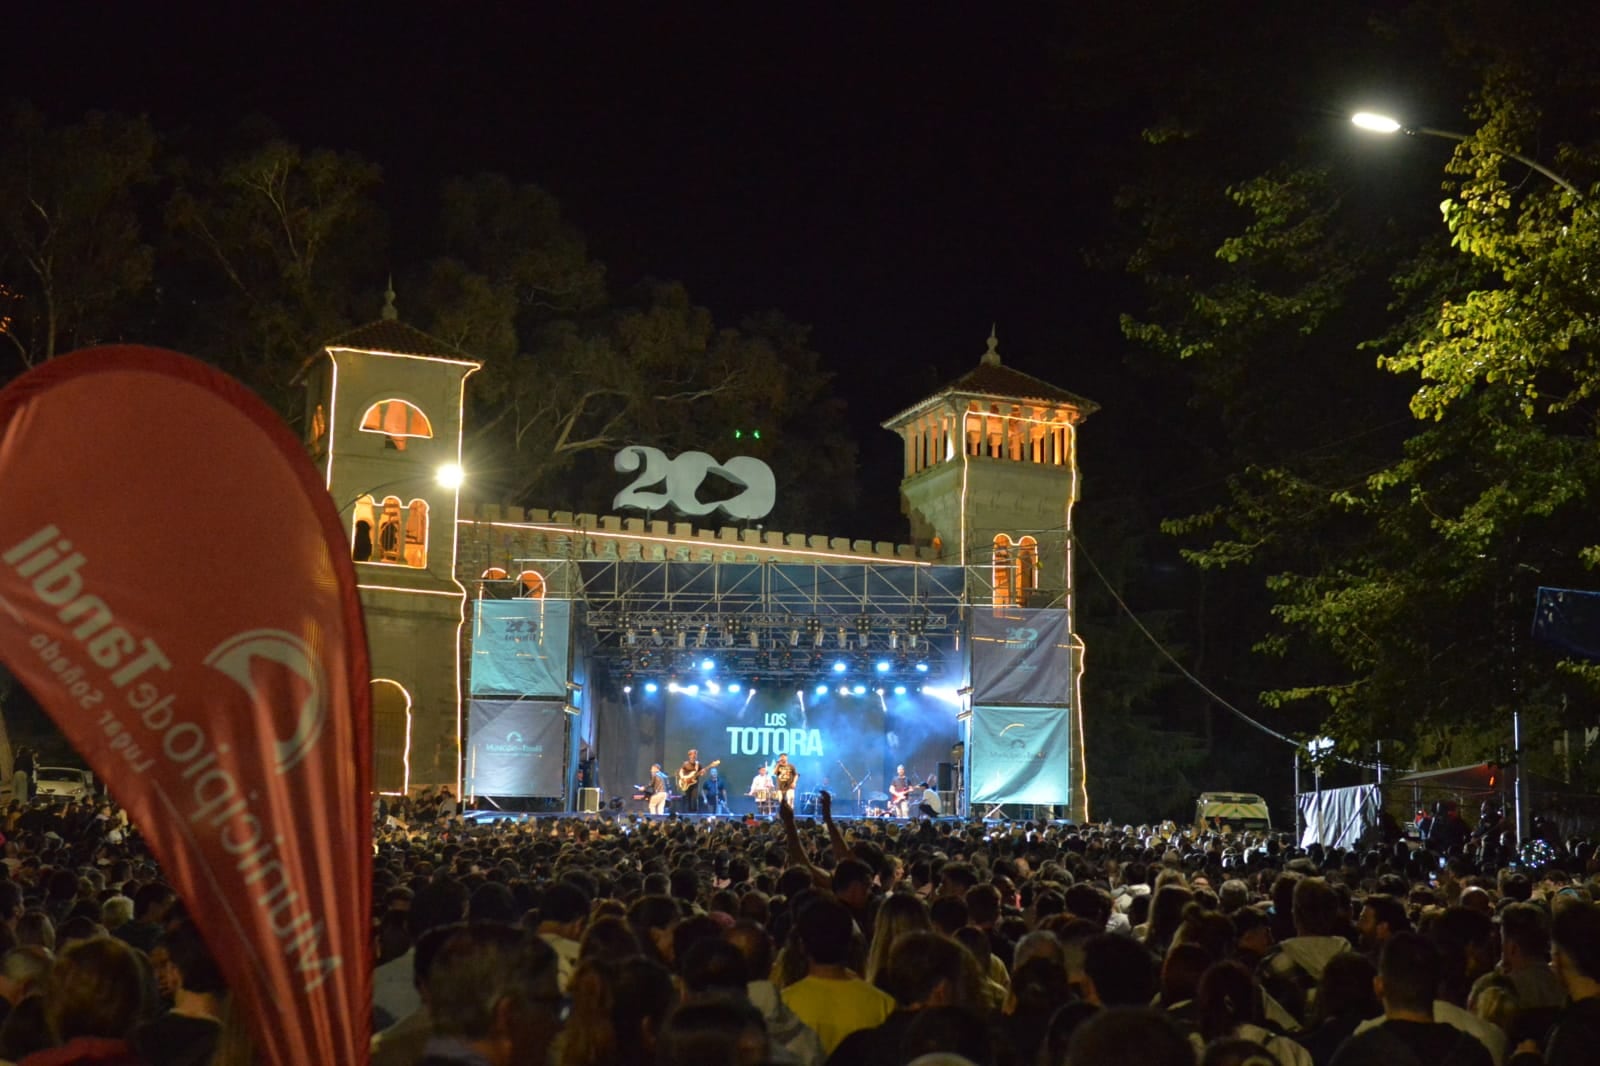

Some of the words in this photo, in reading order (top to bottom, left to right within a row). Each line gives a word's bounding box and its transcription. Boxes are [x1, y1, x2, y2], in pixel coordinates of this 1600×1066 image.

[612, 445, 777, 521] 200
[764, 713, 787, 727] LOS
[726, 727, 824, 757] TOTORA
